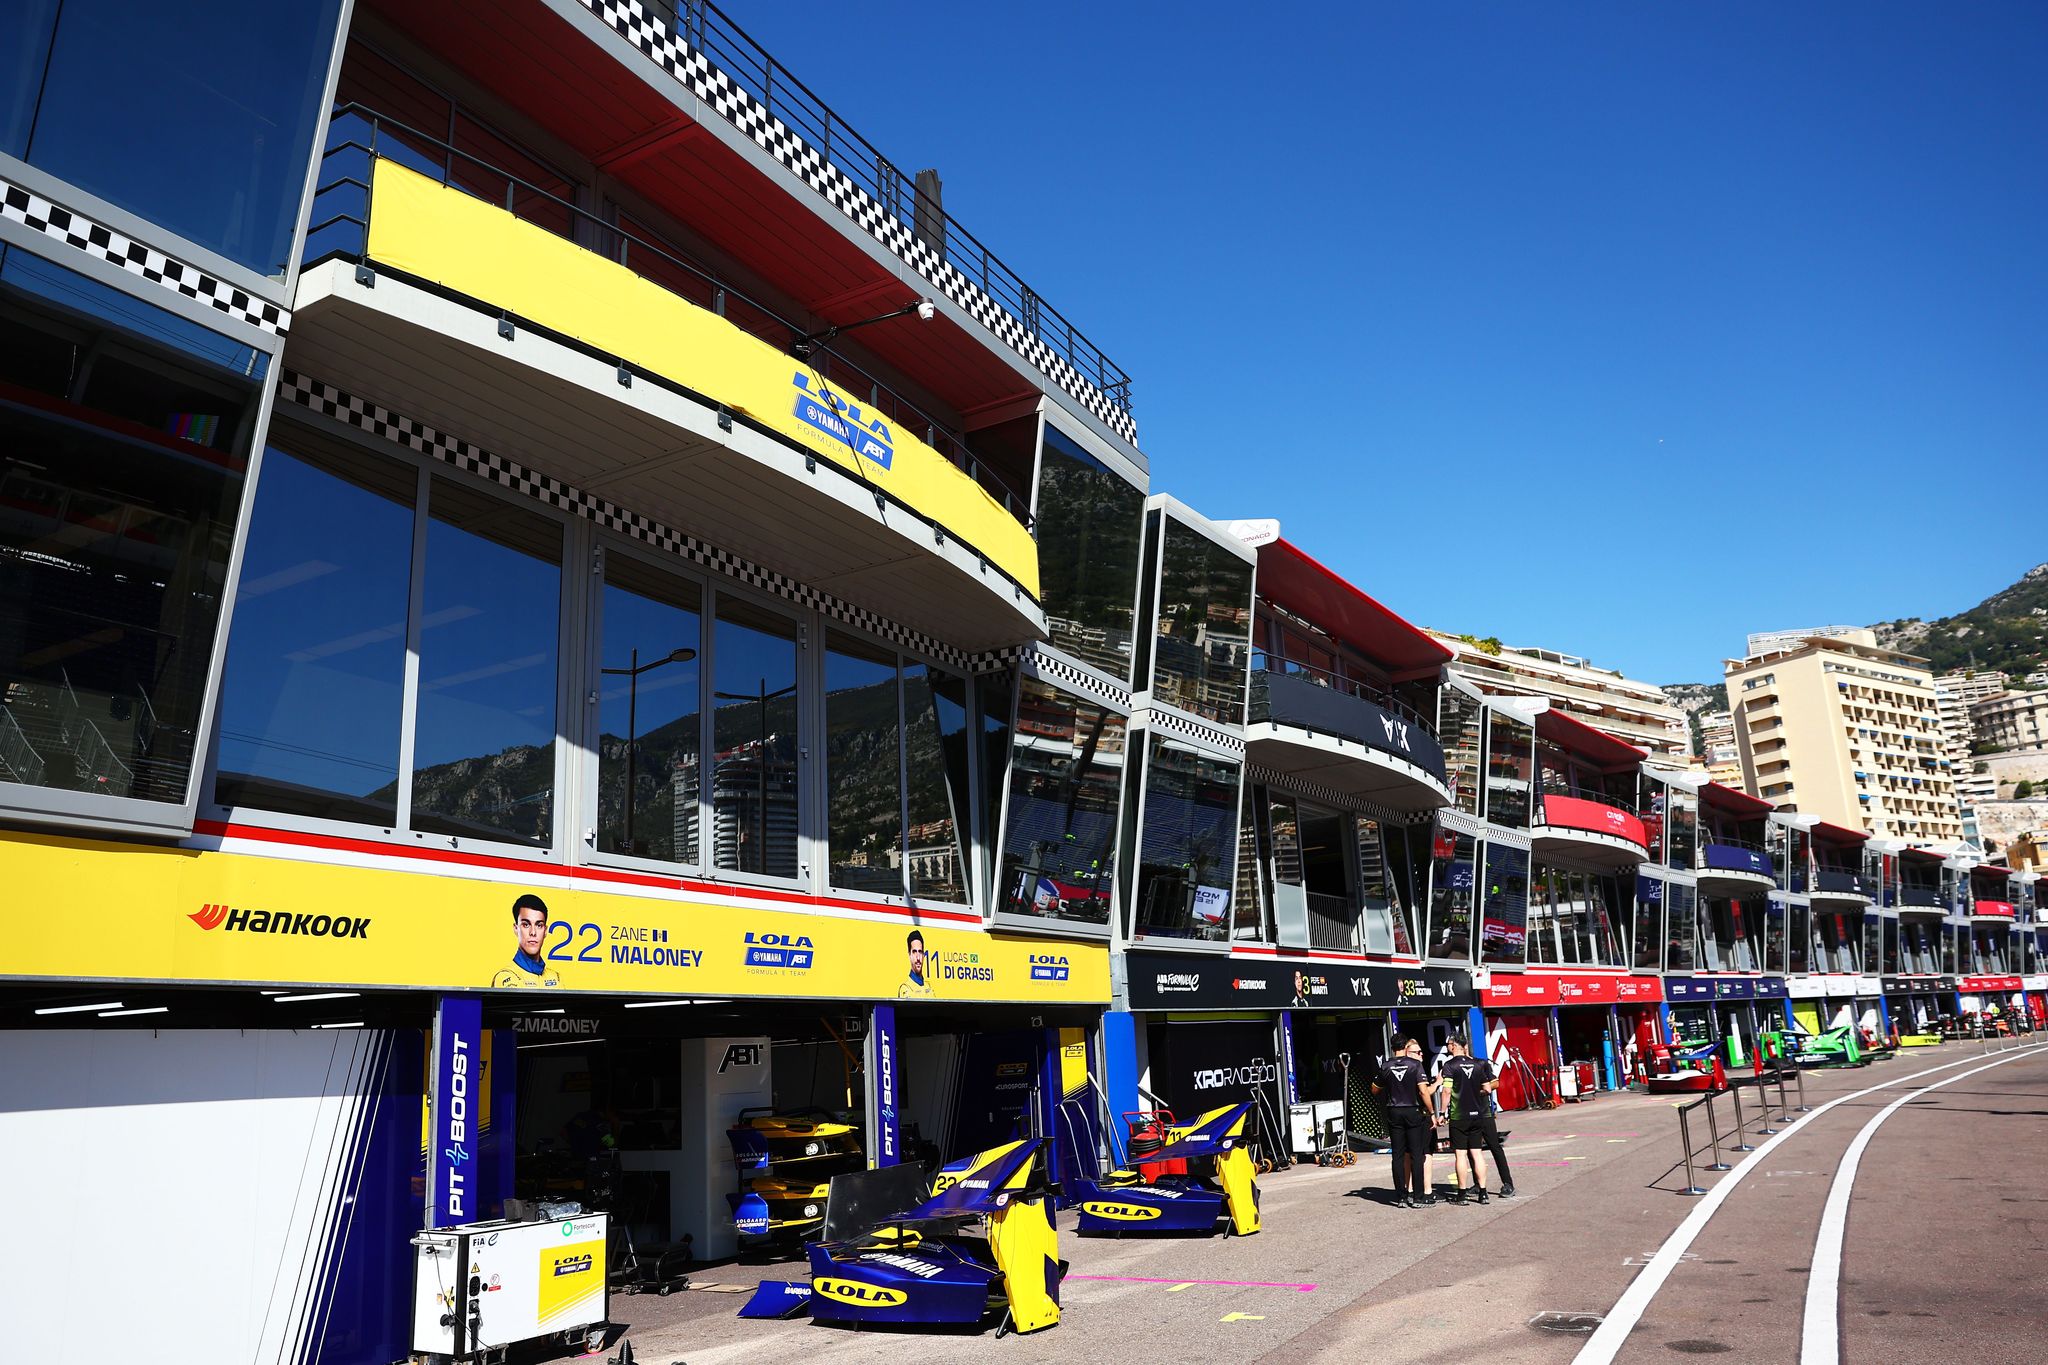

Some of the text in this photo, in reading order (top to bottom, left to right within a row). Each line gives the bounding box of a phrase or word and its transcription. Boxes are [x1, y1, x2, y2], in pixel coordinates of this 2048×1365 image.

[793, 372, 893, 444] LOLA
[817, 410, 885, 460] YAMAHA ABT
[797, 423, 844, 454] FORMULA
[862, 459, 884, 477] TEAM
[1241, 532, 1271, 542] ONACO
[547, 920, 648, 962] 22 ZANE
[744, 932, 813, 948] LOLA
[611, 945, 703, 967] MALONEY
[760, 952, 808, 966] YAMAHA ABT
[924, 949, 968, 978] 11 LUCAS
[1029, 955, 1069, 965] LOLA
[746, 968, 778, 976] FORMULA
[944, 966, 994, 981] DI GRASSI
[511, 1018, 600, 1033] Z.MALONEY
[717, 1044, 763, 1074] ABT
[881, 1030, 893, 1156] PIT BOOST
[449, 1033, 468, 1216] PIT BOOST
[967, 1180, 990, 1189] YAMAHA
[1090, 1204, 1153, 1217] LOLA
[554, 1254, 592, 1266] LOLA
[875, 1254, 945, 1279] YAMAHA
[821, 1281, 898, 1302] LOLA
